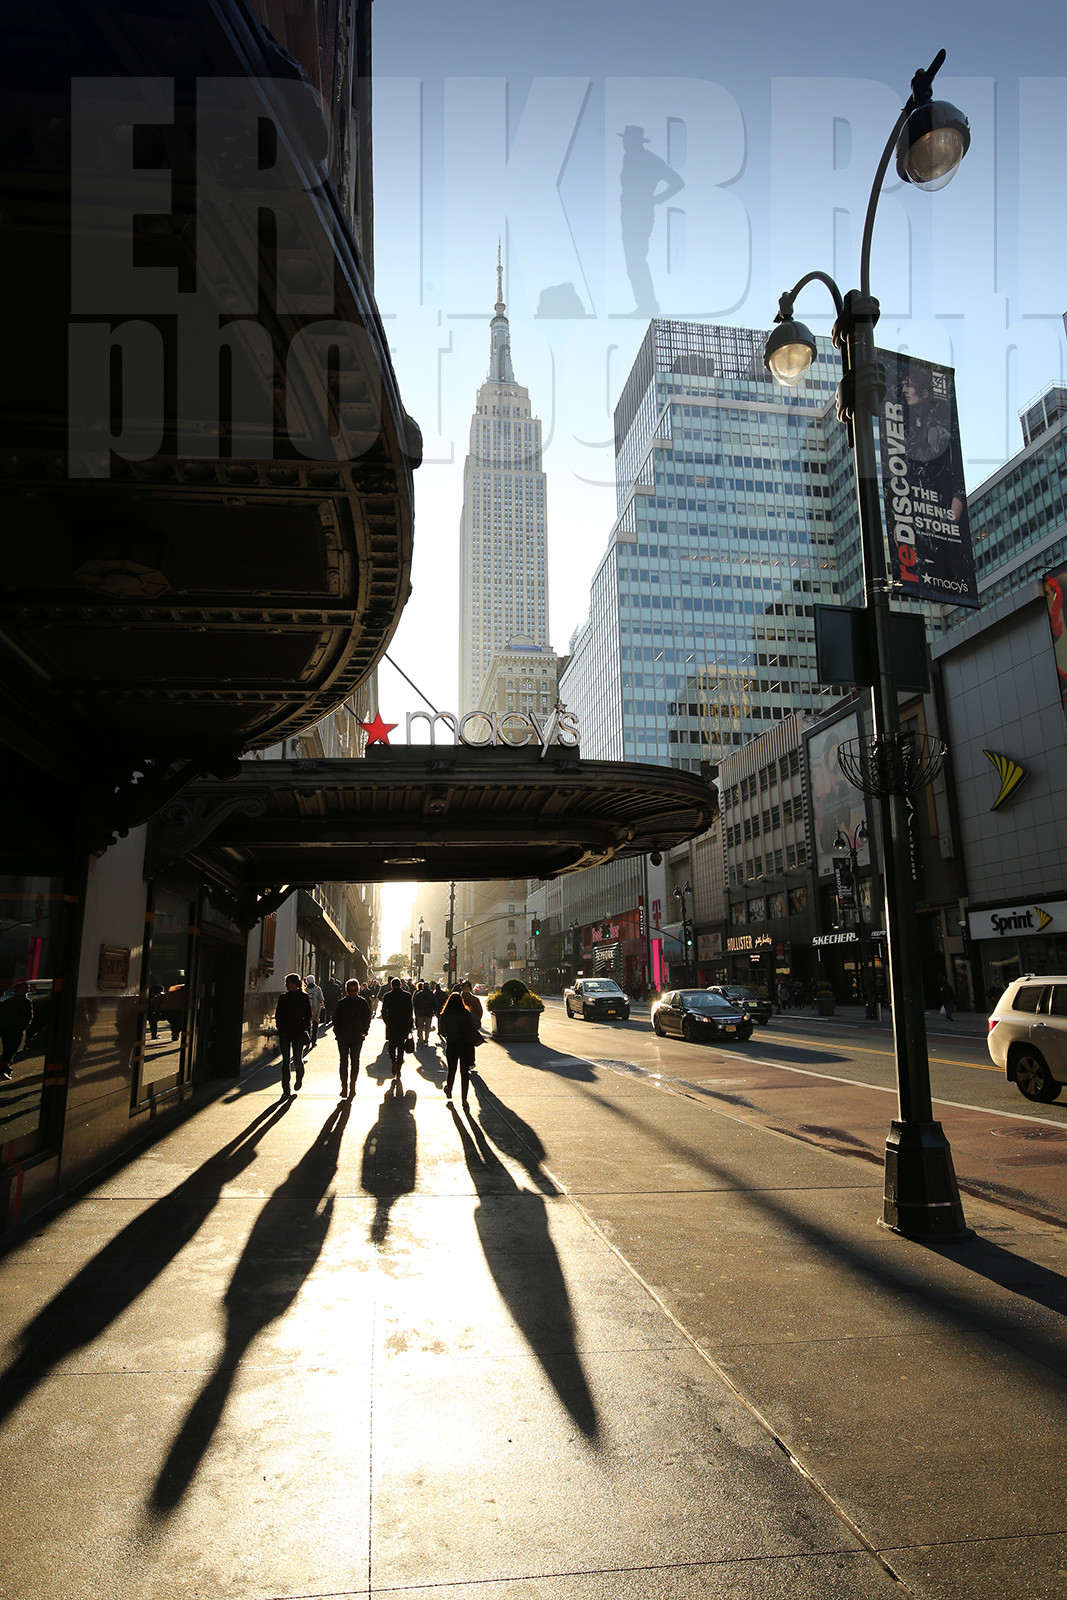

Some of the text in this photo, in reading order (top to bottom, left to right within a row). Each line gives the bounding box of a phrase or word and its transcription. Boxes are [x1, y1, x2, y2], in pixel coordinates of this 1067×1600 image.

[911, 485, 939, 503] THE
[912, 501, 957, 521] MEN'S
[914, 516, 961, 537] STORE
[991, 910, 1034, 935] Sprint
[726, 935, 753, 951] HOLLISTER
[811, 932, 860, 947] SKECHERS
